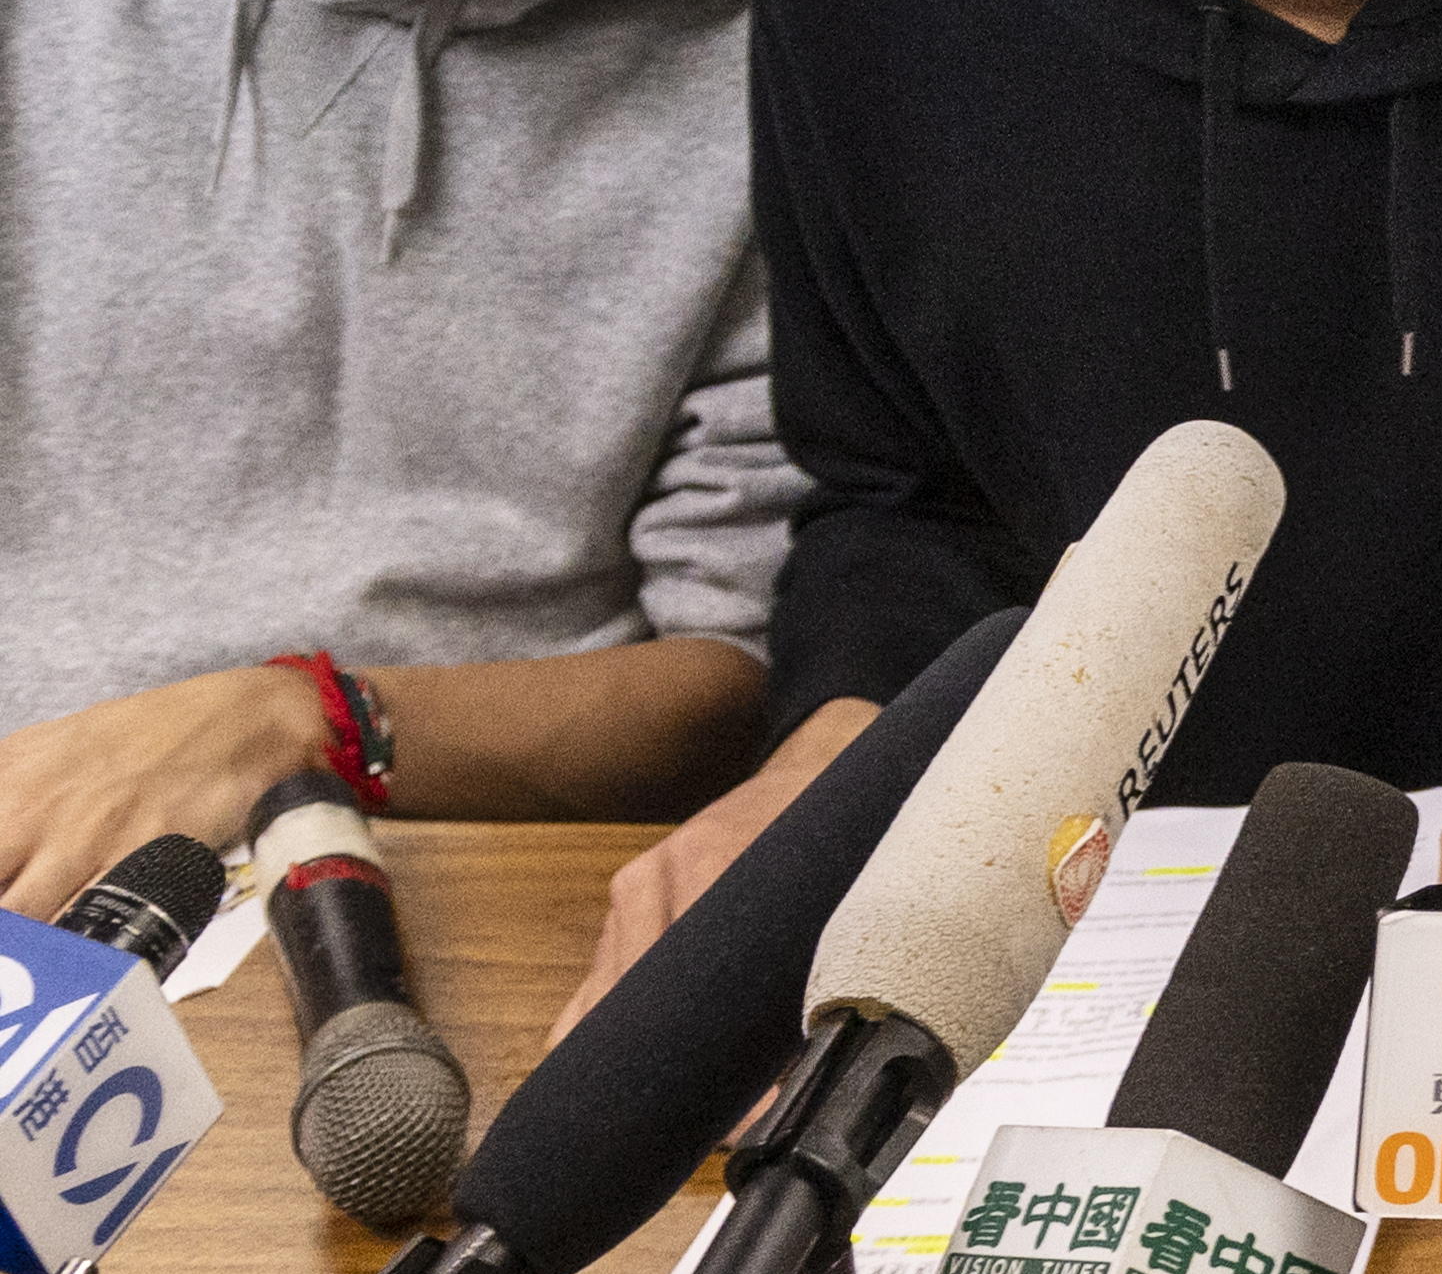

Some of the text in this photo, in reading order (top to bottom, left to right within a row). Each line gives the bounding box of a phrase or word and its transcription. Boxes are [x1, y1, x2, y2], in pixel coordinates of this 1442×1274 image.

[1118, 561, 1245, 819] REUTERS
[960, 1181, 1142, 1253] 看中國
